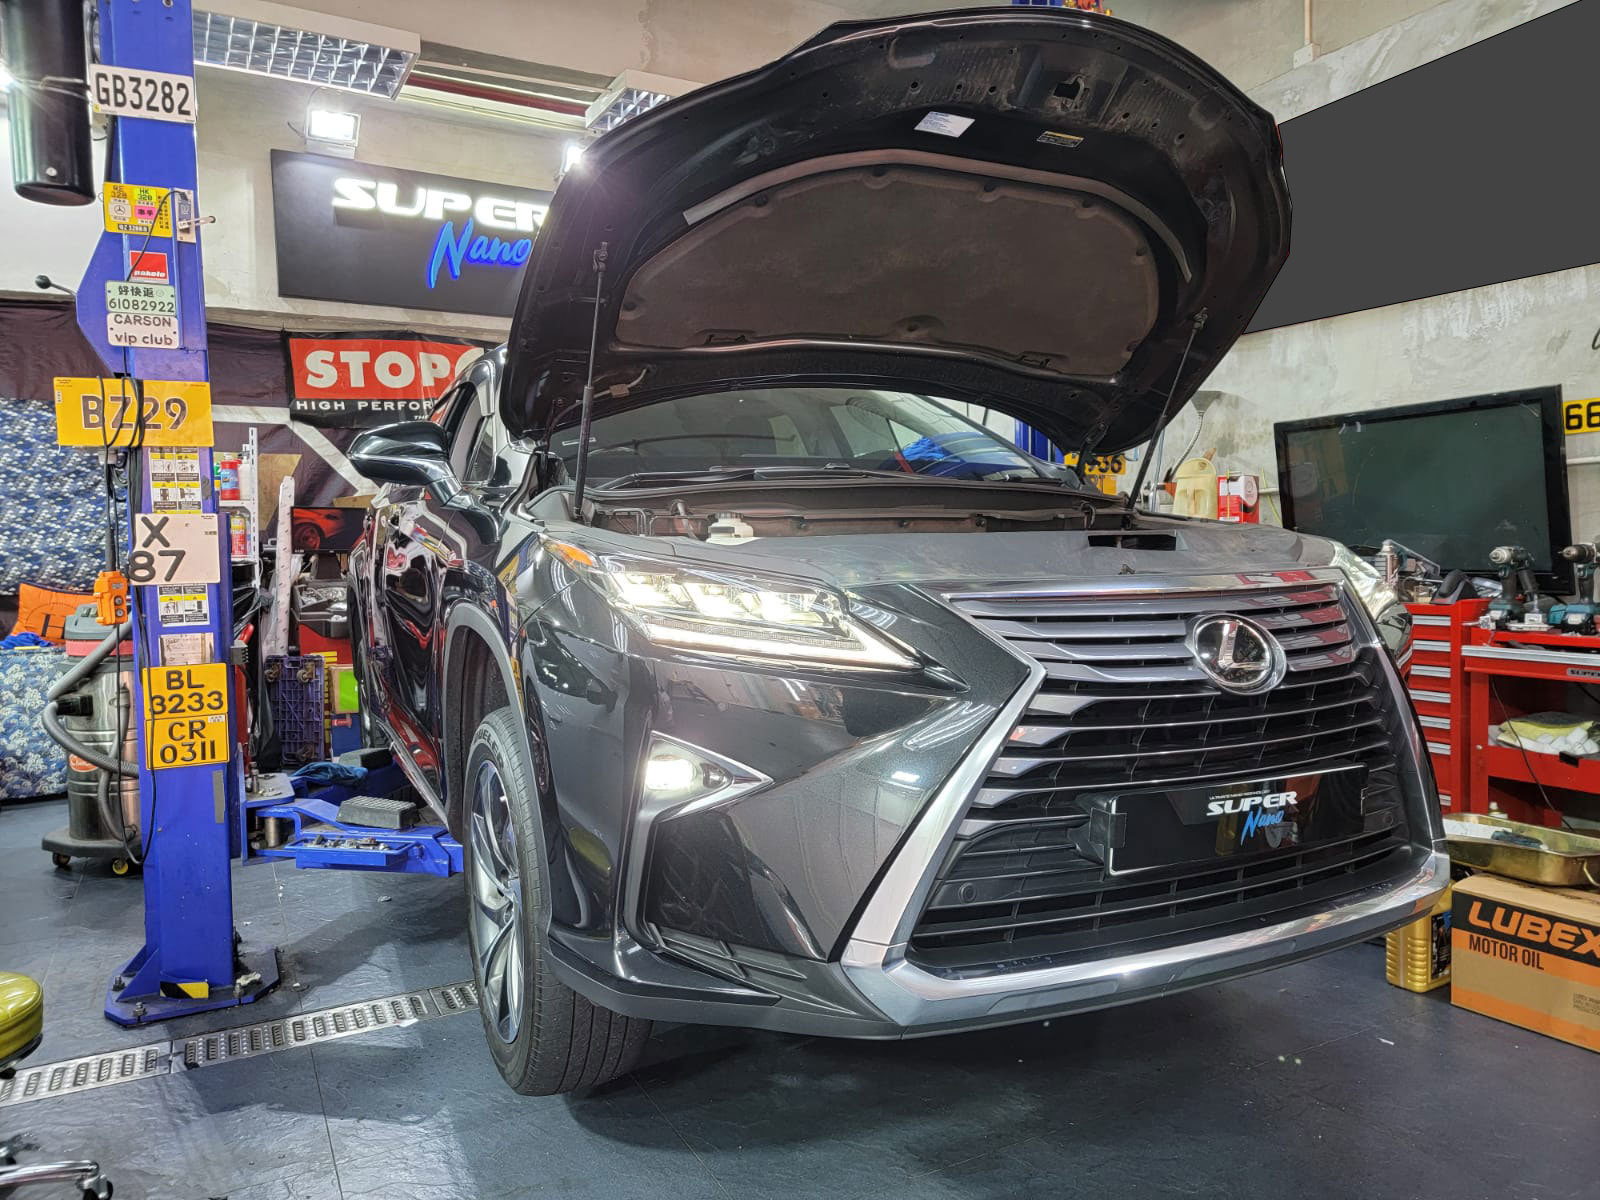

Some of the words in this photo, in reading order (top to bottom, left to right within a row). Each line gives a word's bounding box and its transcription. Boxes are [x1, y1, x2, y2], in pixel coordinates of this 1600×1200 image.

[95, 72, 191, 116] GB3282
[426, 218, 531, 289] Nano
[109, 298, 175, 313] 61082922
[113, 314, 172, 327] CARSON
[115, 332, 138, 346] vip
[142, 334, 173, 346] club
[296, 400, 346, 411] HIGH
[357, 400, 435, 412] PERFOR
[140, 515, 171, 549] X
[127, 549, 186, 583] 87
[165, 669, 205, 691] BL
[149, 690, 224, 715] 3233
[168, 719, 206, 742] CR
[1206, 790, 1298, 817] SUPER
[1240, 806, 1285, 847] Nano
[1469, 934, 1518, 963] MOTOR
[1522, 949, 1545, 971] OIL
